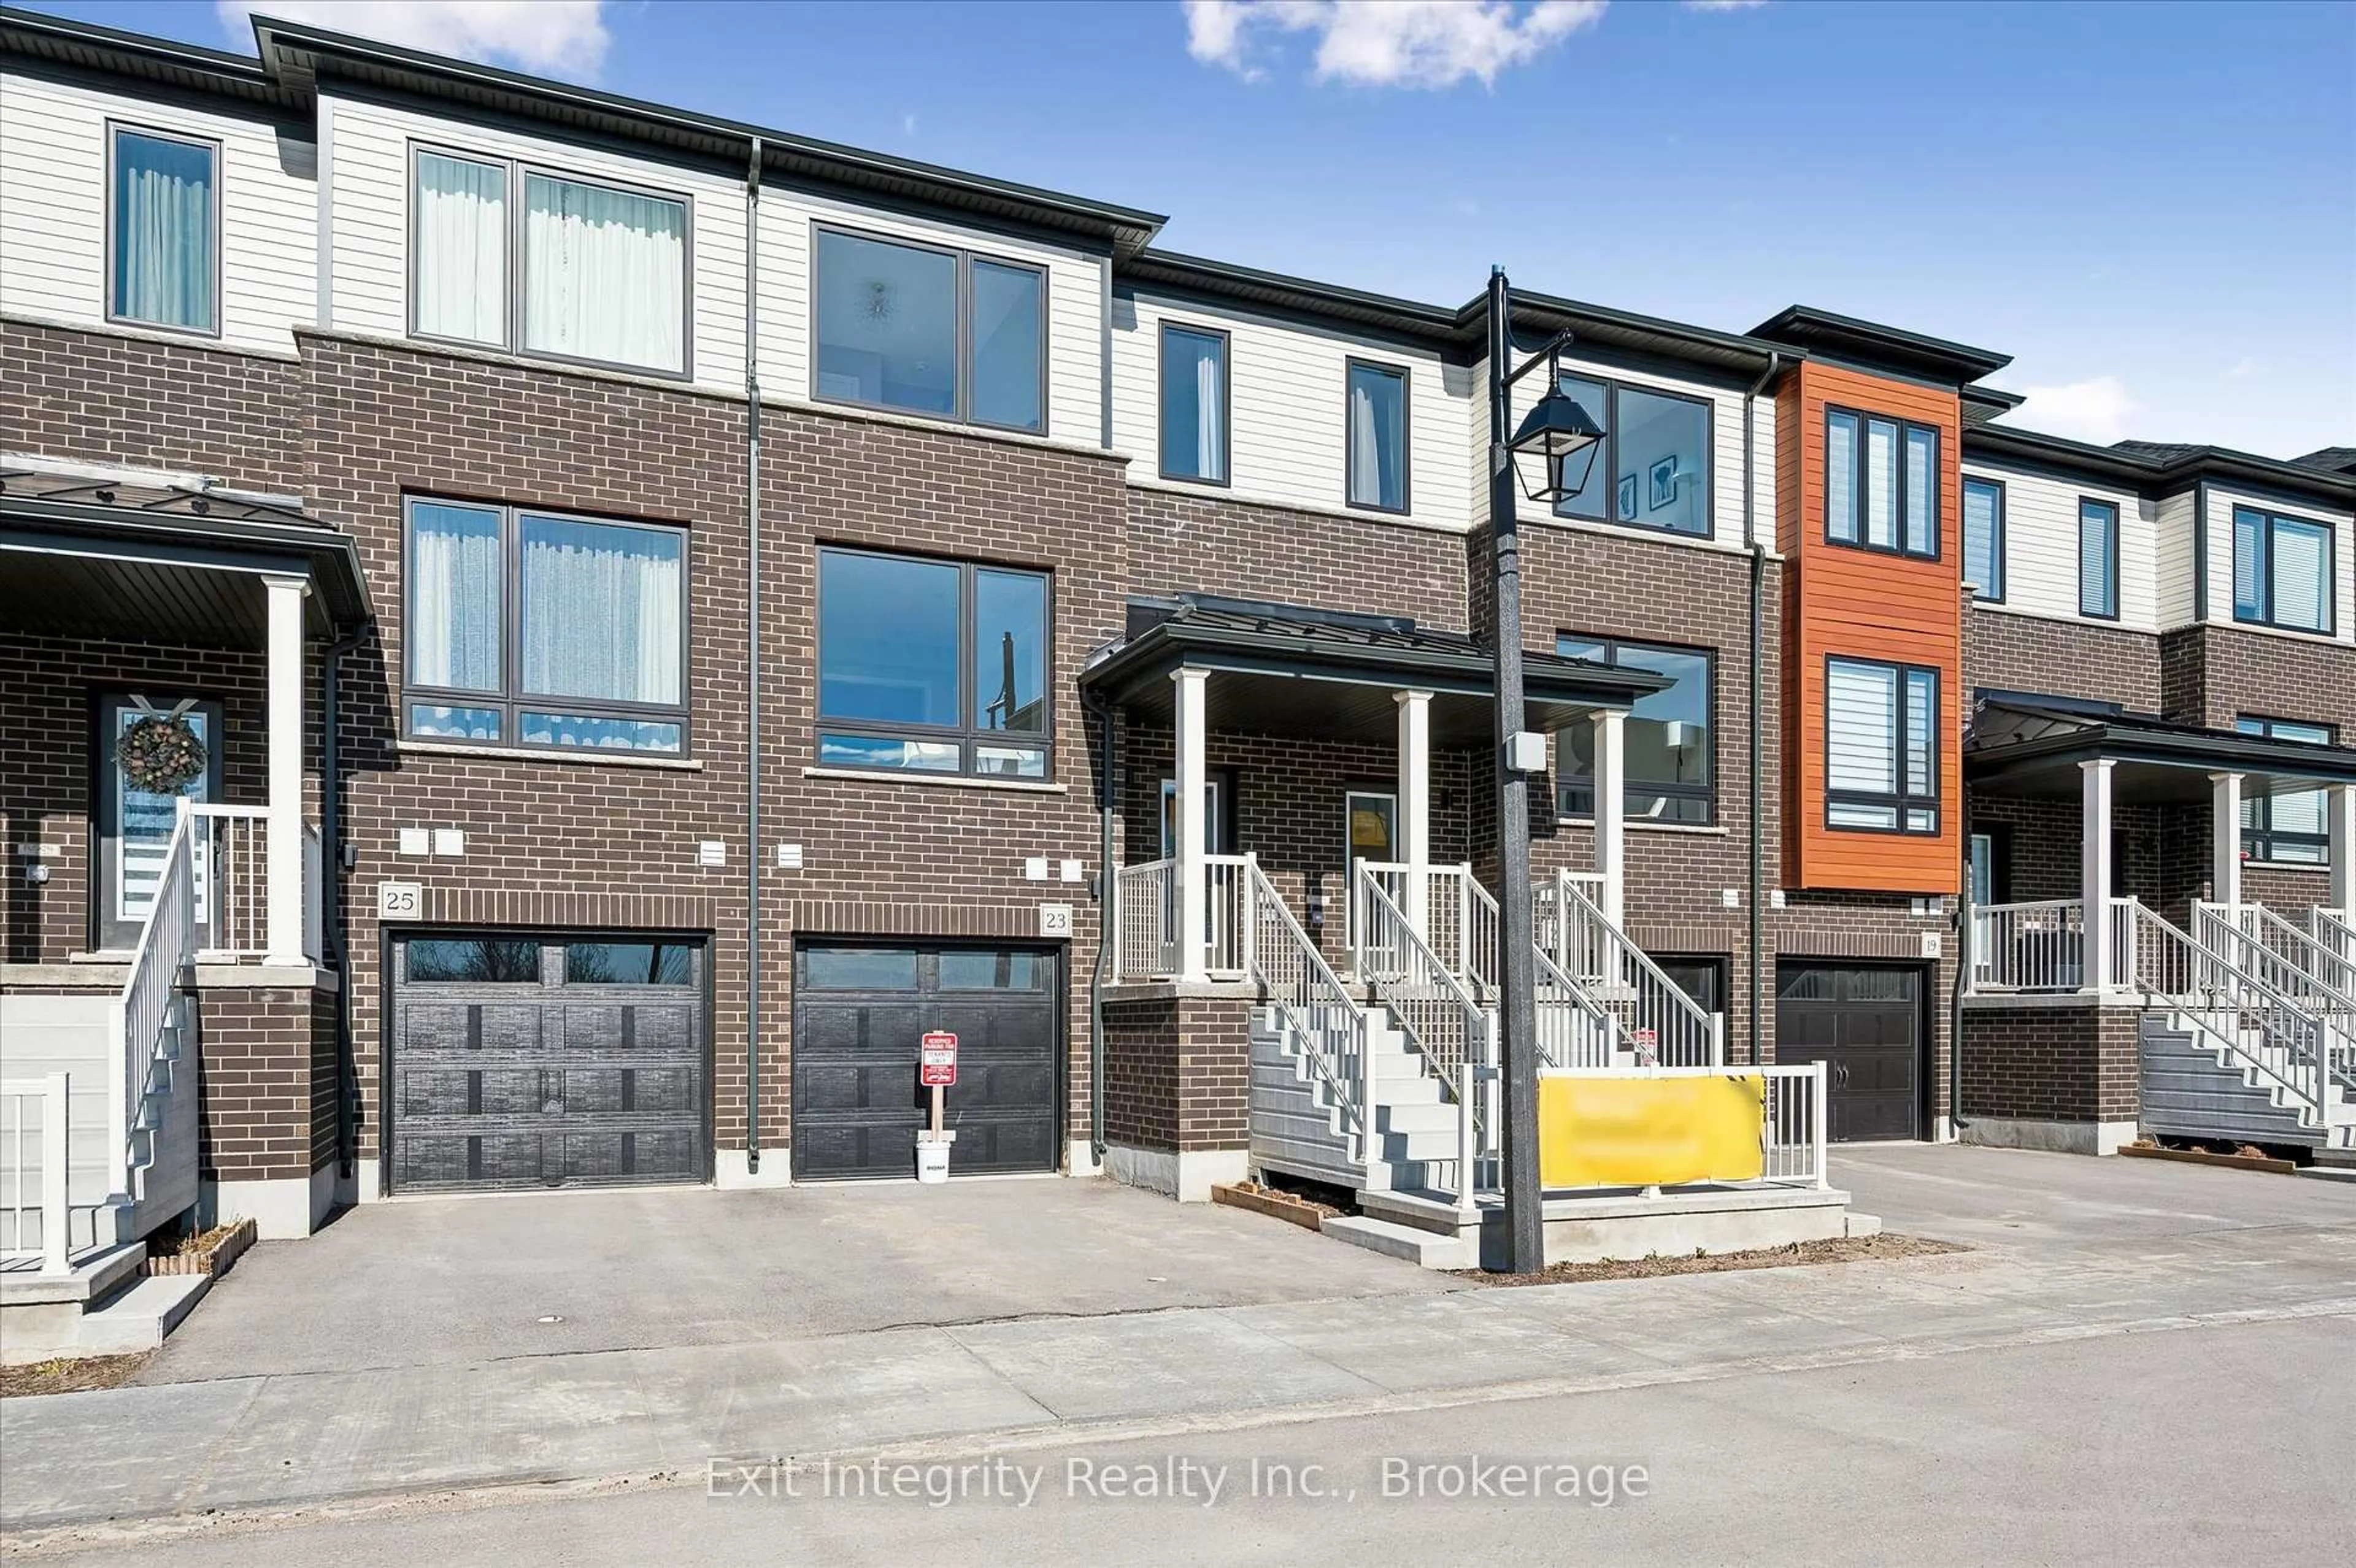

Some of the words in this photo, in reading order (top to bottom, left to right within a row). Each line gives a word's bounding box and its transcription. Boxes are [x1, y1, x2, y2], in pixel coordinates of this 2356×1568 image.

[387, 892, 414, 910] 25
[1047, 912, 1066, 928] 23
[1927, 939, 1936, 951] 19
